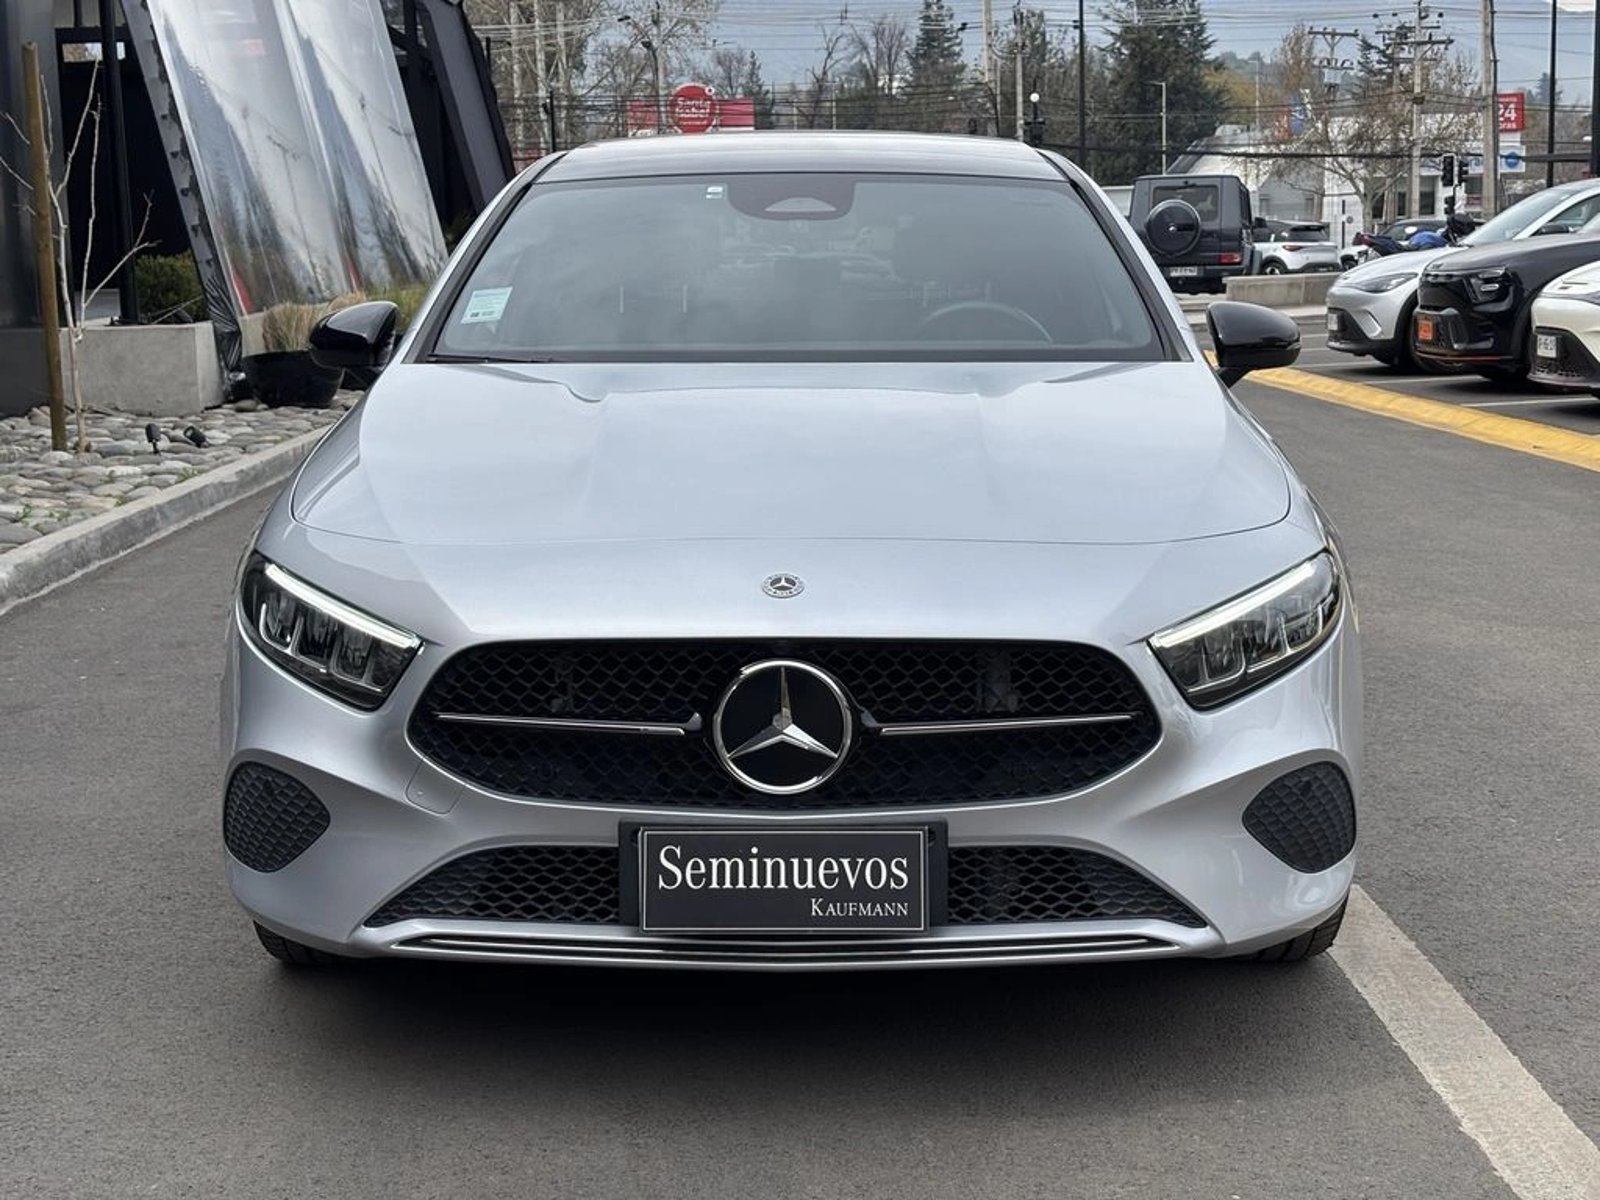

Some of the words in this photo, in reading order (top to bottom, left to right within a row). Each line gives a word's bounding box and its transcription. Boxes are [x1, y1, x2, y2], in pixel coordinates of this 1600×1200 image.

[1498, 103, 1517, 121] 24
[658, 845, 909, 890] Seminuevos
[811, 898, 909, 917] KAUFMANN
